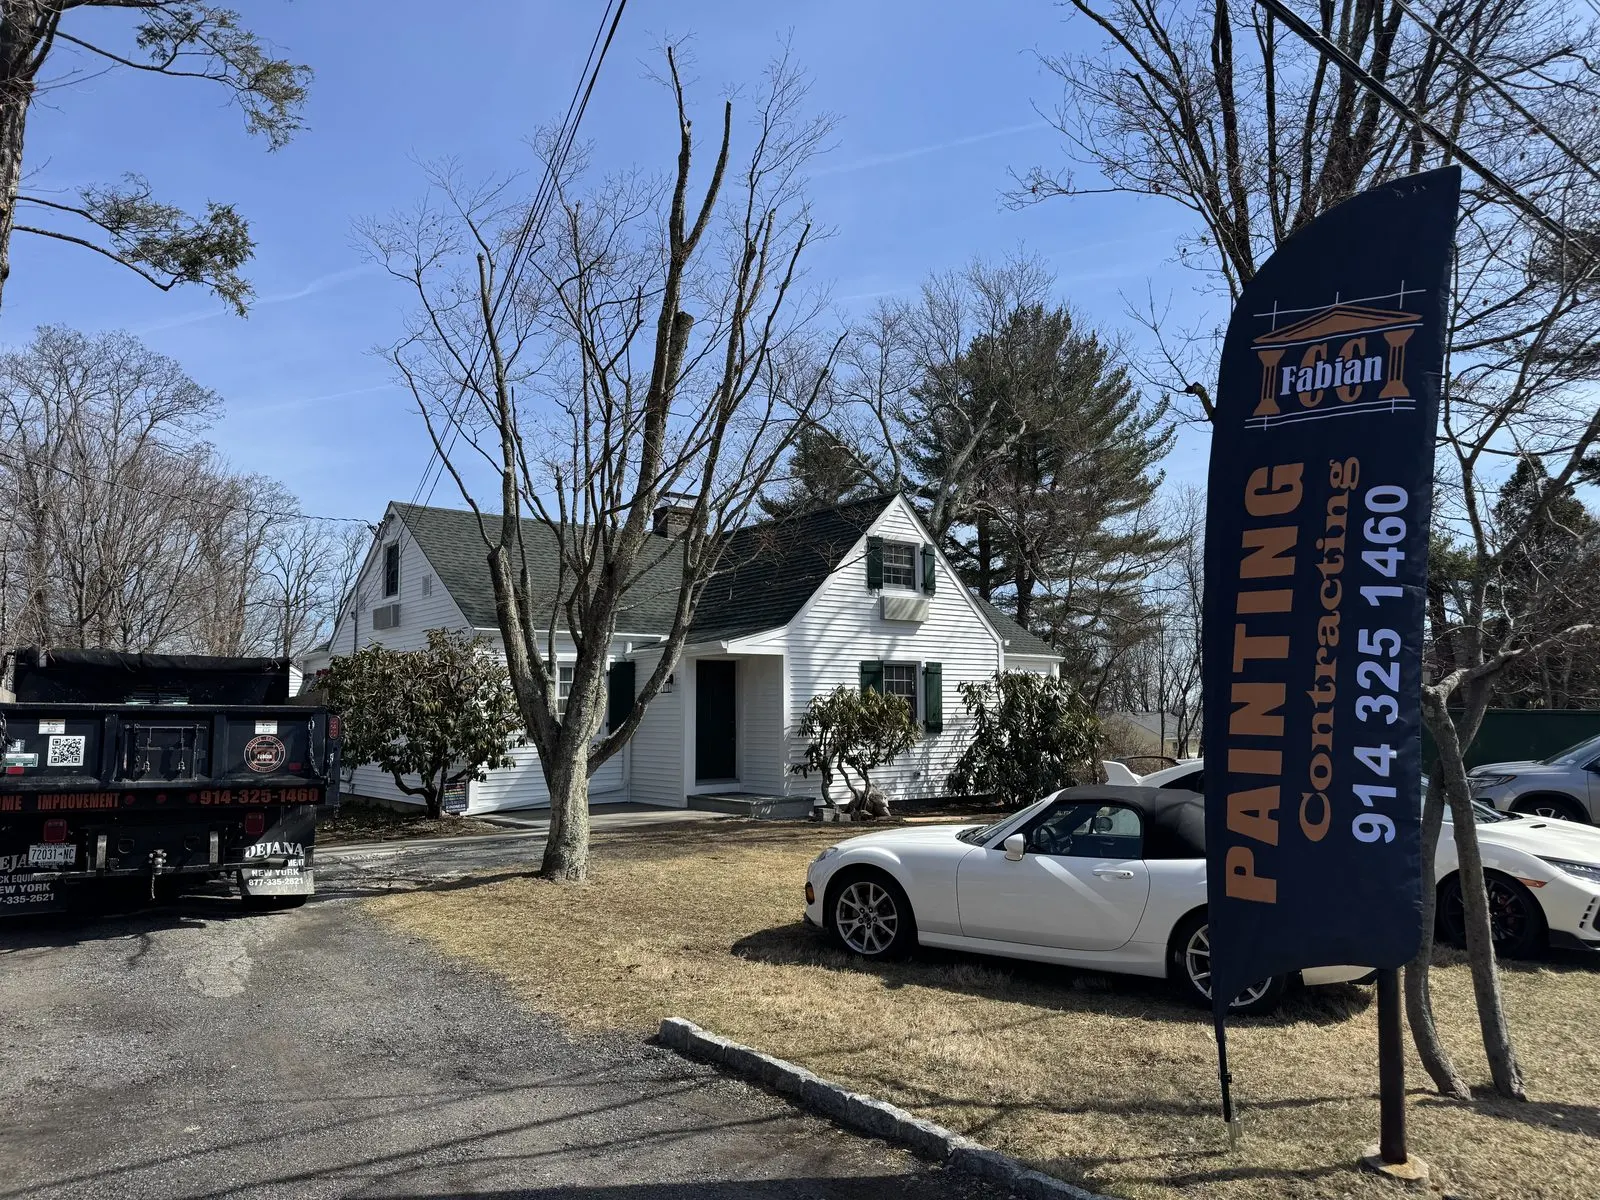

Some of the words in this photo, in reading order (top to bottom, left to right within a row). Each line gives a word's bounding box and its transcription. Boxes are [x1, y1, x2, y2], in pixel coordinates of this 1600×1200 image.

[1279, 355, 1383, 396] Fabian
[1360, 485, 1409, 607] 1460
[1225, 462, 1304, 904] PAINTING
[1299, 456, 1360, 842] Contracting
[1355, 628, 1401, 725] 325
[0, 795, 22, 811] ME
[37, 792, 120, 810] IMPROVEMENT
[200, 788, 319, 805] 914-325-1460
[1352, 743, 1397, 844] 914
[245, 841, 304, 859] DEJANA
[251, 869, 273, 877] NEW
[0, 885, 16, 894] EW
[19, 882, 51, 893] YORK
